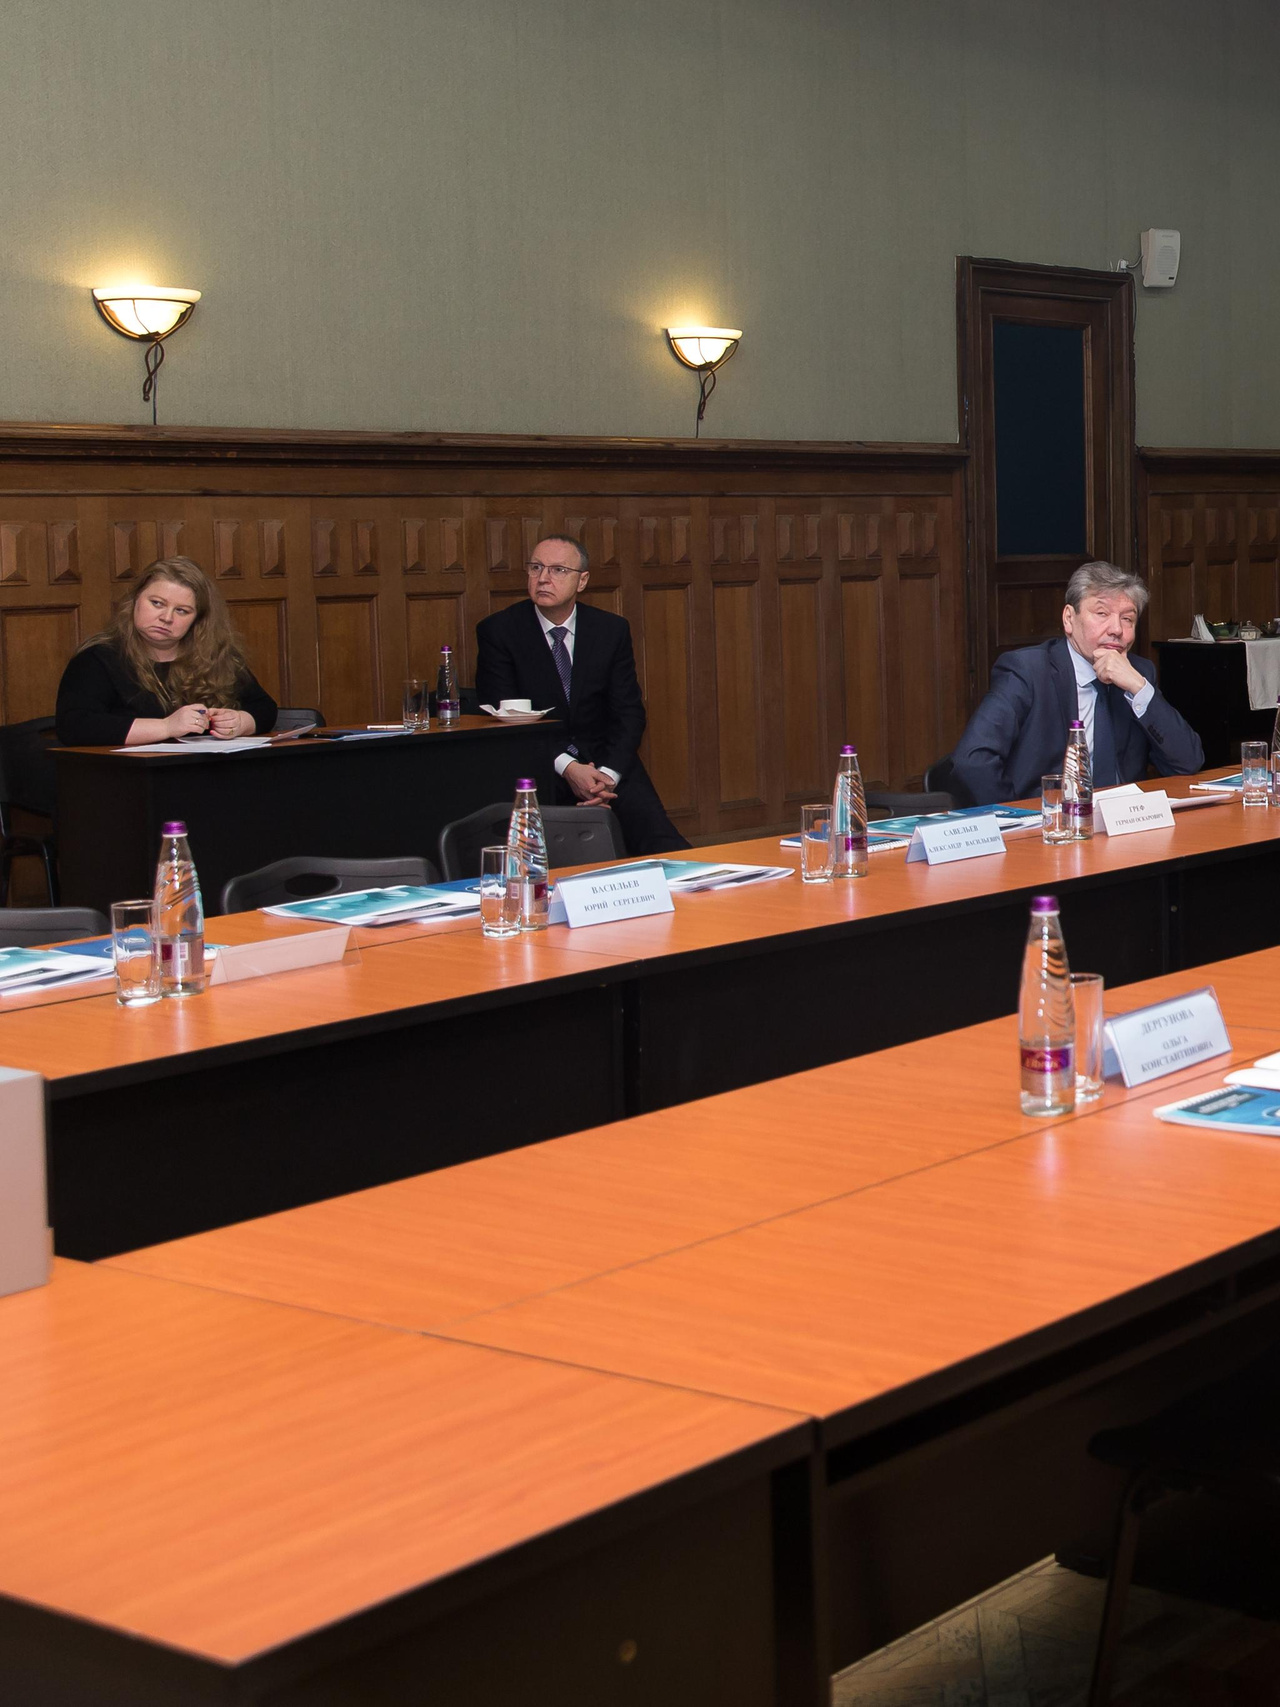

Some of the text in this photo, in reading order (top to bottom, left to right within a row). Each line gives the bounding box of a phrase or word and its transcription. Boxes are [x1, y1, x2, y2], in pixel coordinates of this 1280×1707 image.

[1129, 804, 1145, 813] ГРЕФ
[943, 824, 979, 837] САВЕЛЬЕВ
[928, 835, 1001, 854] АЛЕКСАНДР ВАСИЛЬЕВИЧ
[591, 880, 640, 894] ВАСИЛЬЕВ
[584, 894, 656, 912] ЮРИЙ СЕРГЕЕВИЧ
[1141, 1008, 1194, 1035] ДЕРГУНОВА
[1162, 1035, 1188, 1050] ОЛЬГА
[1141, 1040, 1214, 1073] КОНСТАНТИНОВНА
